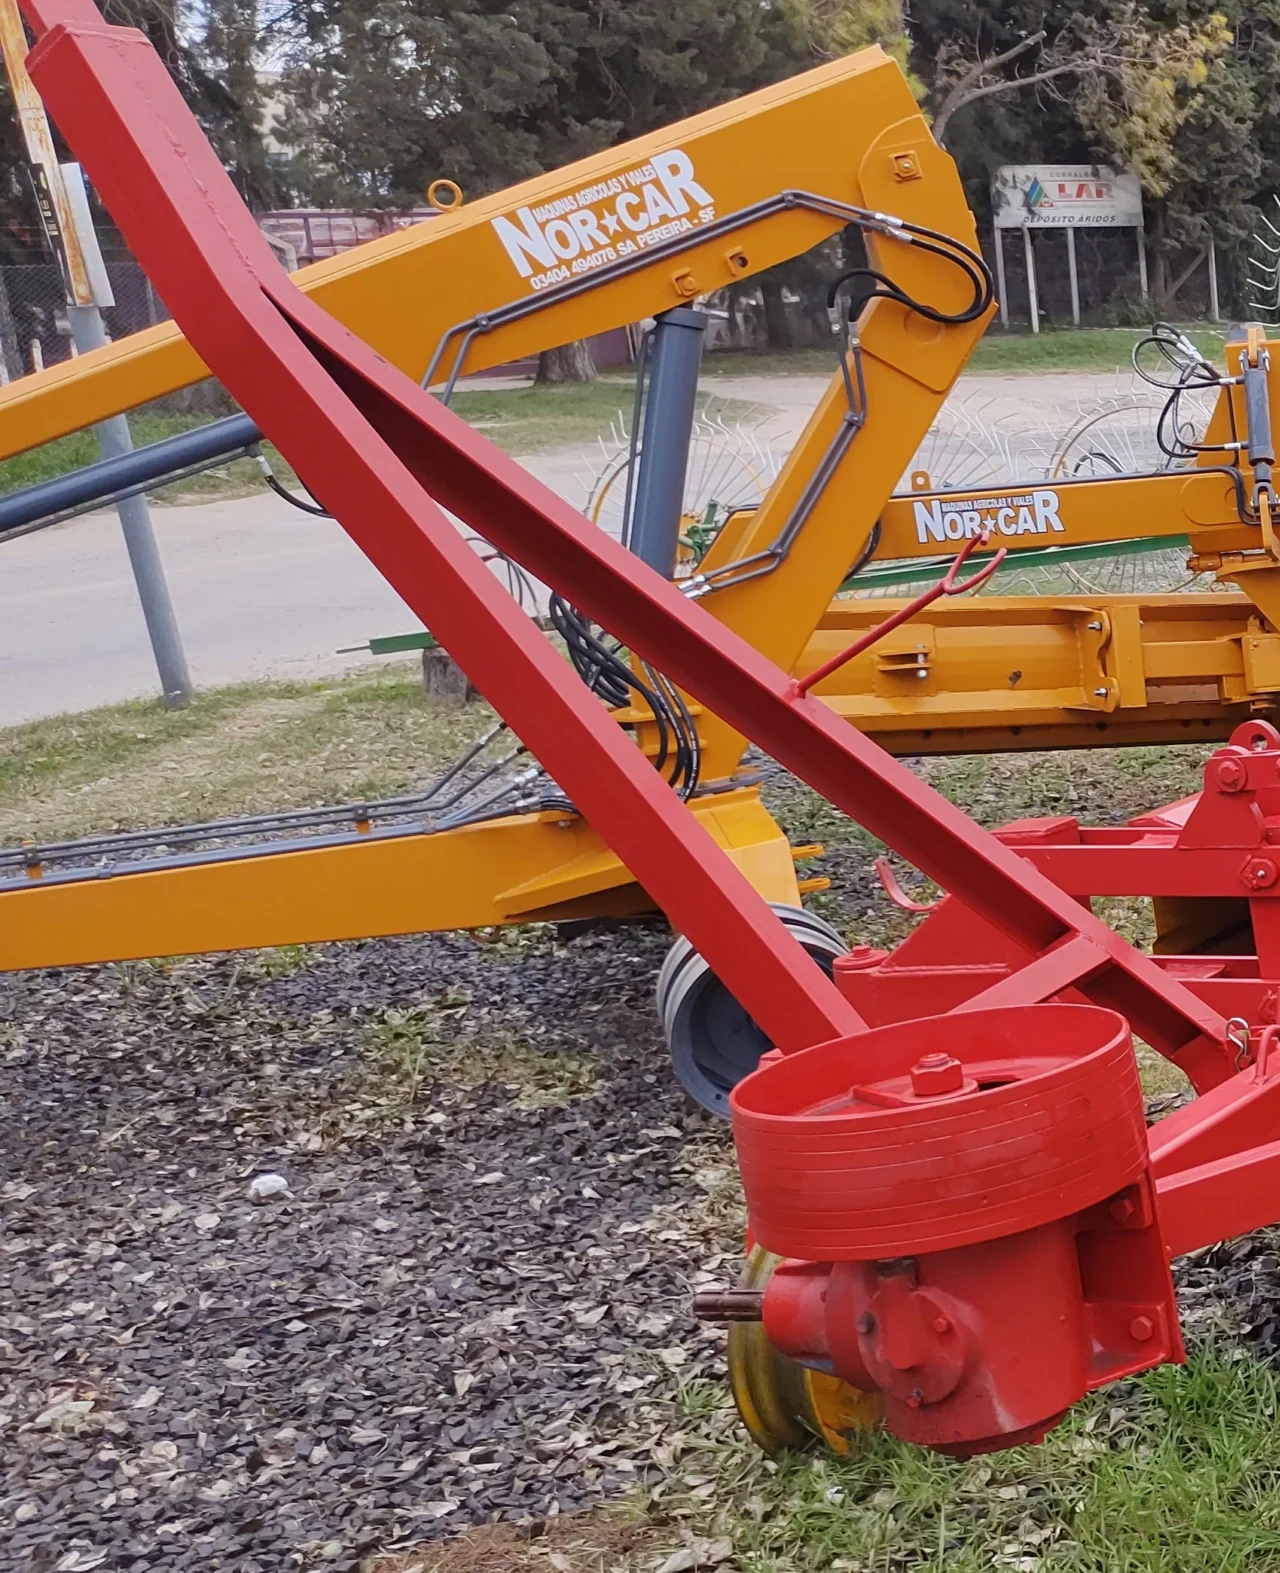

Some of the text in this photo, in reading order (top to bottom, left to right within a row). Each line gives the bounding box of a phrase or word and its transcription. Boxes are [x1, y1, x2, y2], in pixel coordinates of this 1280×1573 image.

[532, 164, 657, 223] MAQUINAS AGRICOLAS Y VIALES
[1057, 183, 1115, 199] LAR
[530, 265, 571, 290] 03404
[571, 247, 617, 273] 494078
[616, 241, 638, 256] SA
[637, 220, 693, 248] PEREIRA
[698, 206, 715, 223] SF
